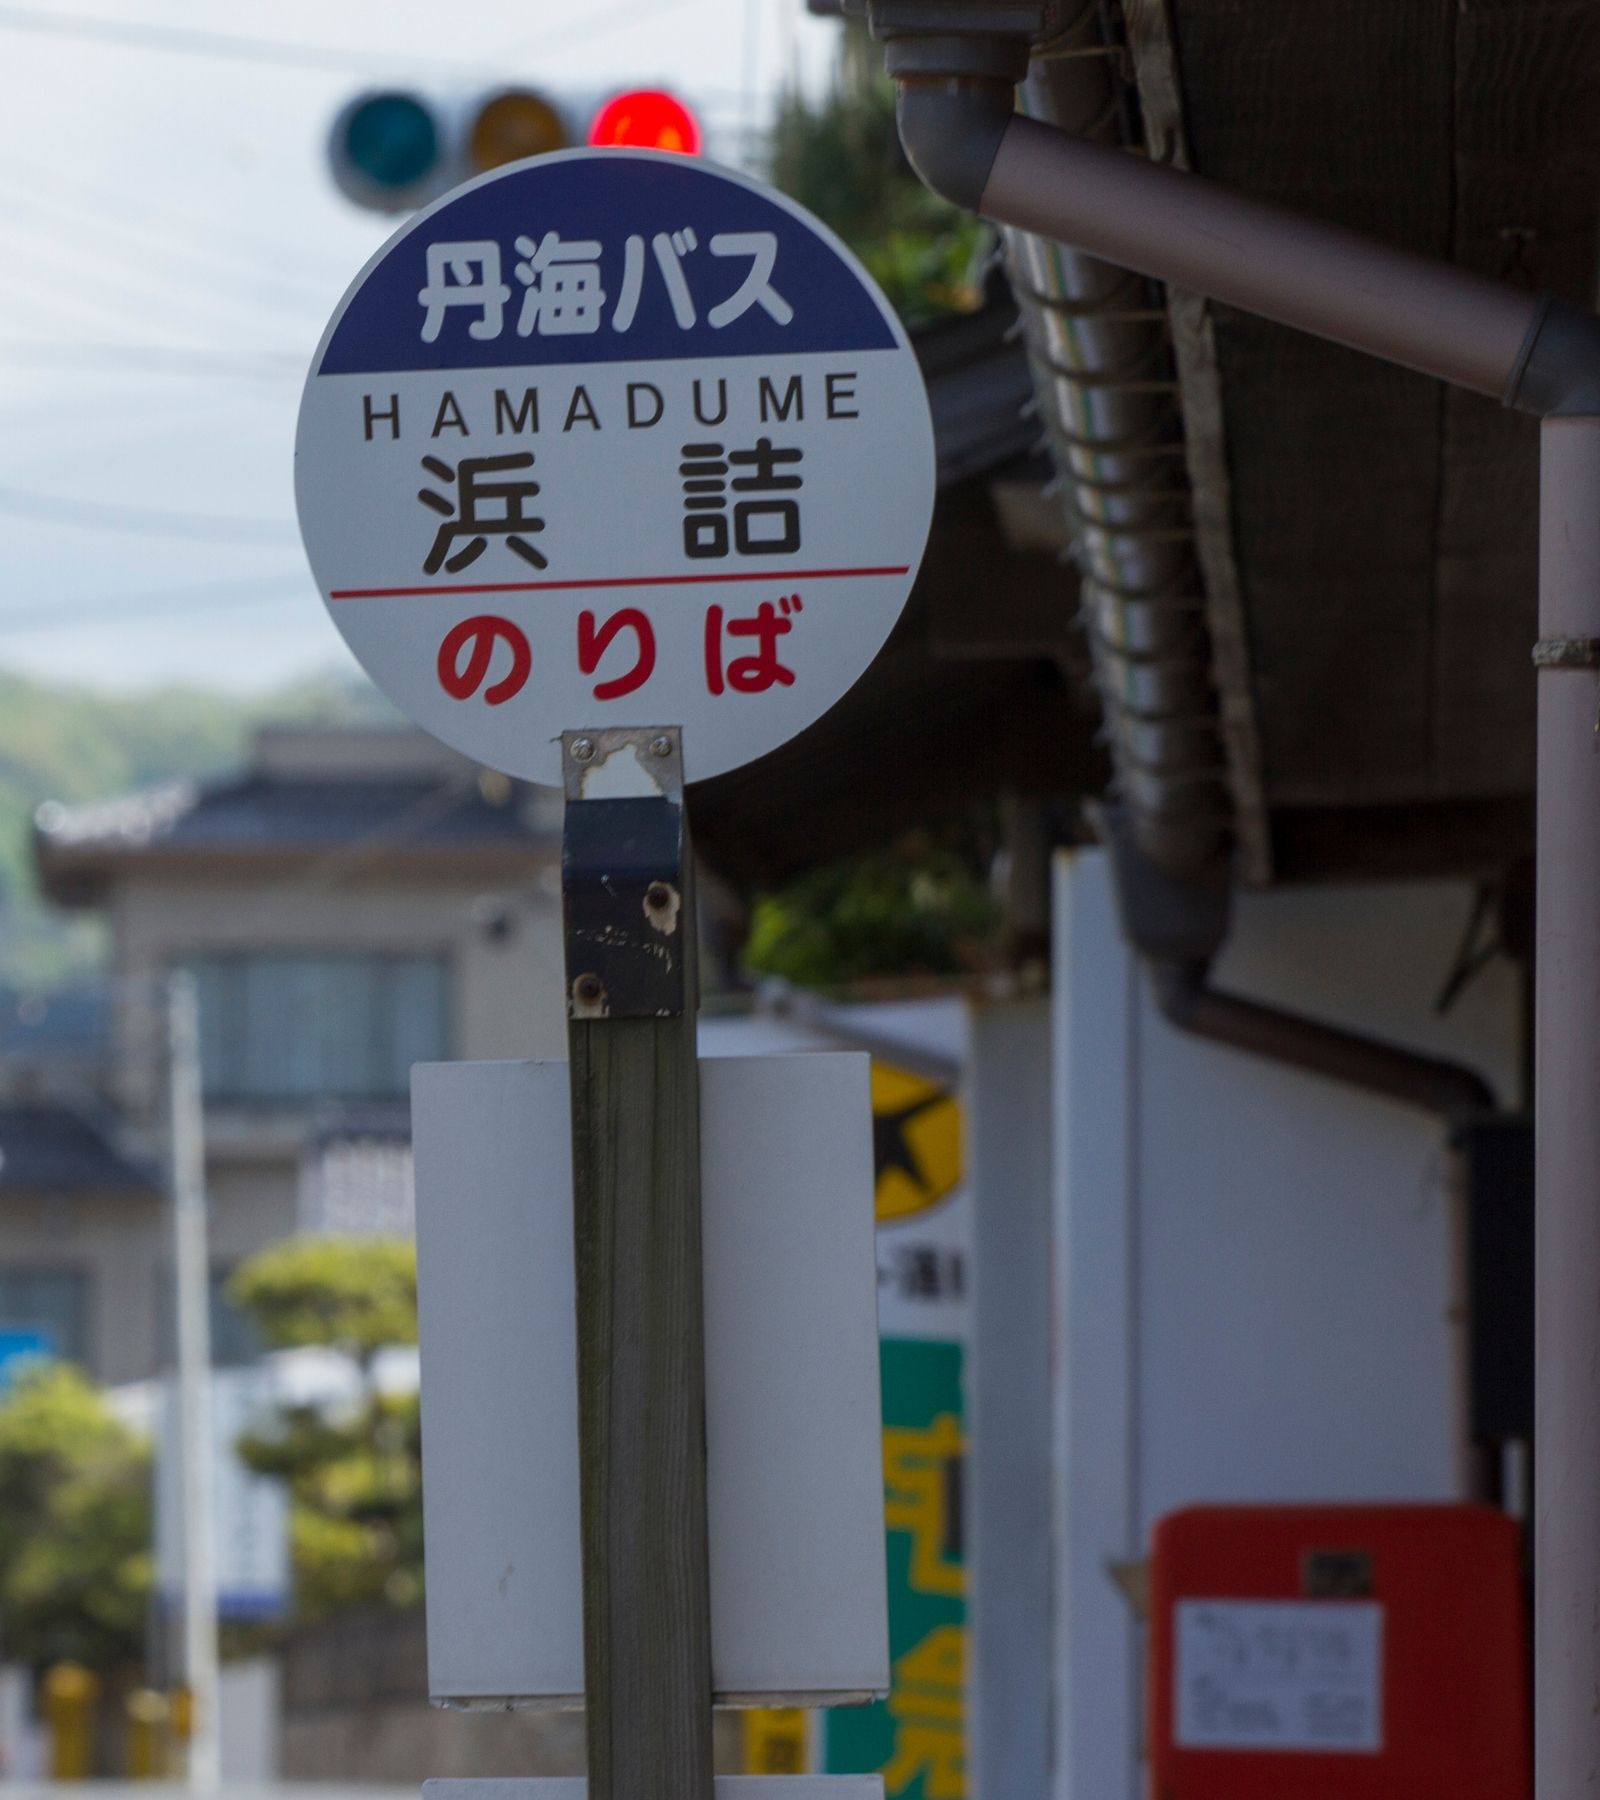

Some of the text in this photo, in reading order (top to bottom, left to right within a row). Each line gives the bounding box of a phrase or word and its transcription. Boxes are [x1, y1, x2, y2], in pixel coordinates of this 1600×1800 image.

[418, 226, 794, 343] 丹海バス
[362, 371, 860, 441] HAMADUME
[417, 437, 804, 576] 浜詰
[436, 594, 804, 706] のりば
